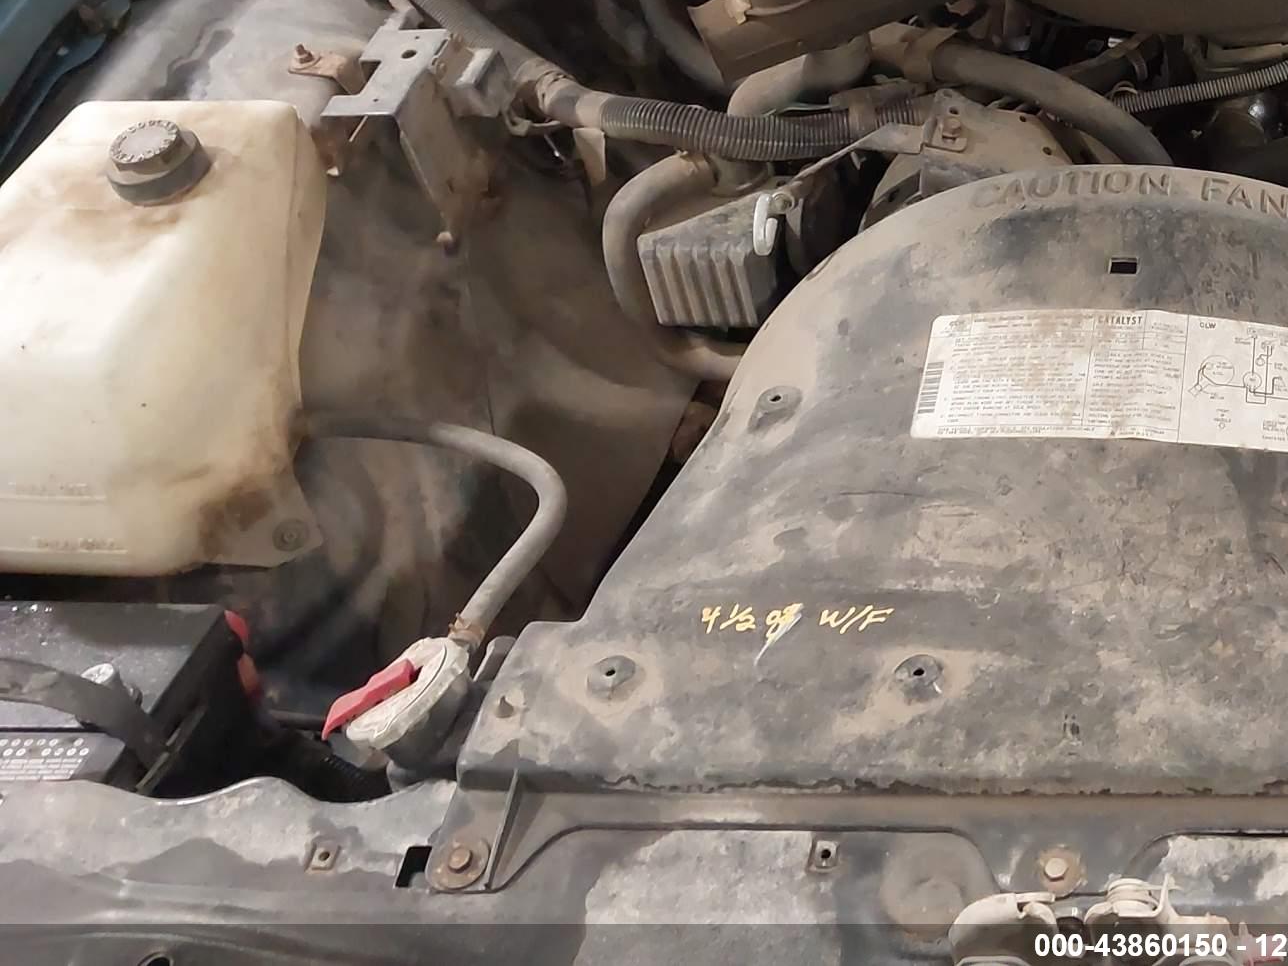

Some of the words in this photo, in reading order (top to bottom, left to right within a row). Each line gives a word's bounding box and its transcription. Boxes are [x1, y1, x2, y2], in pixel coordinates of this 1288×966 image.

[971, 169, 1171, 208] CAUTION
[1098, 315, 1143, 325] CATALYST
[701, 605, 722, 634] 4
